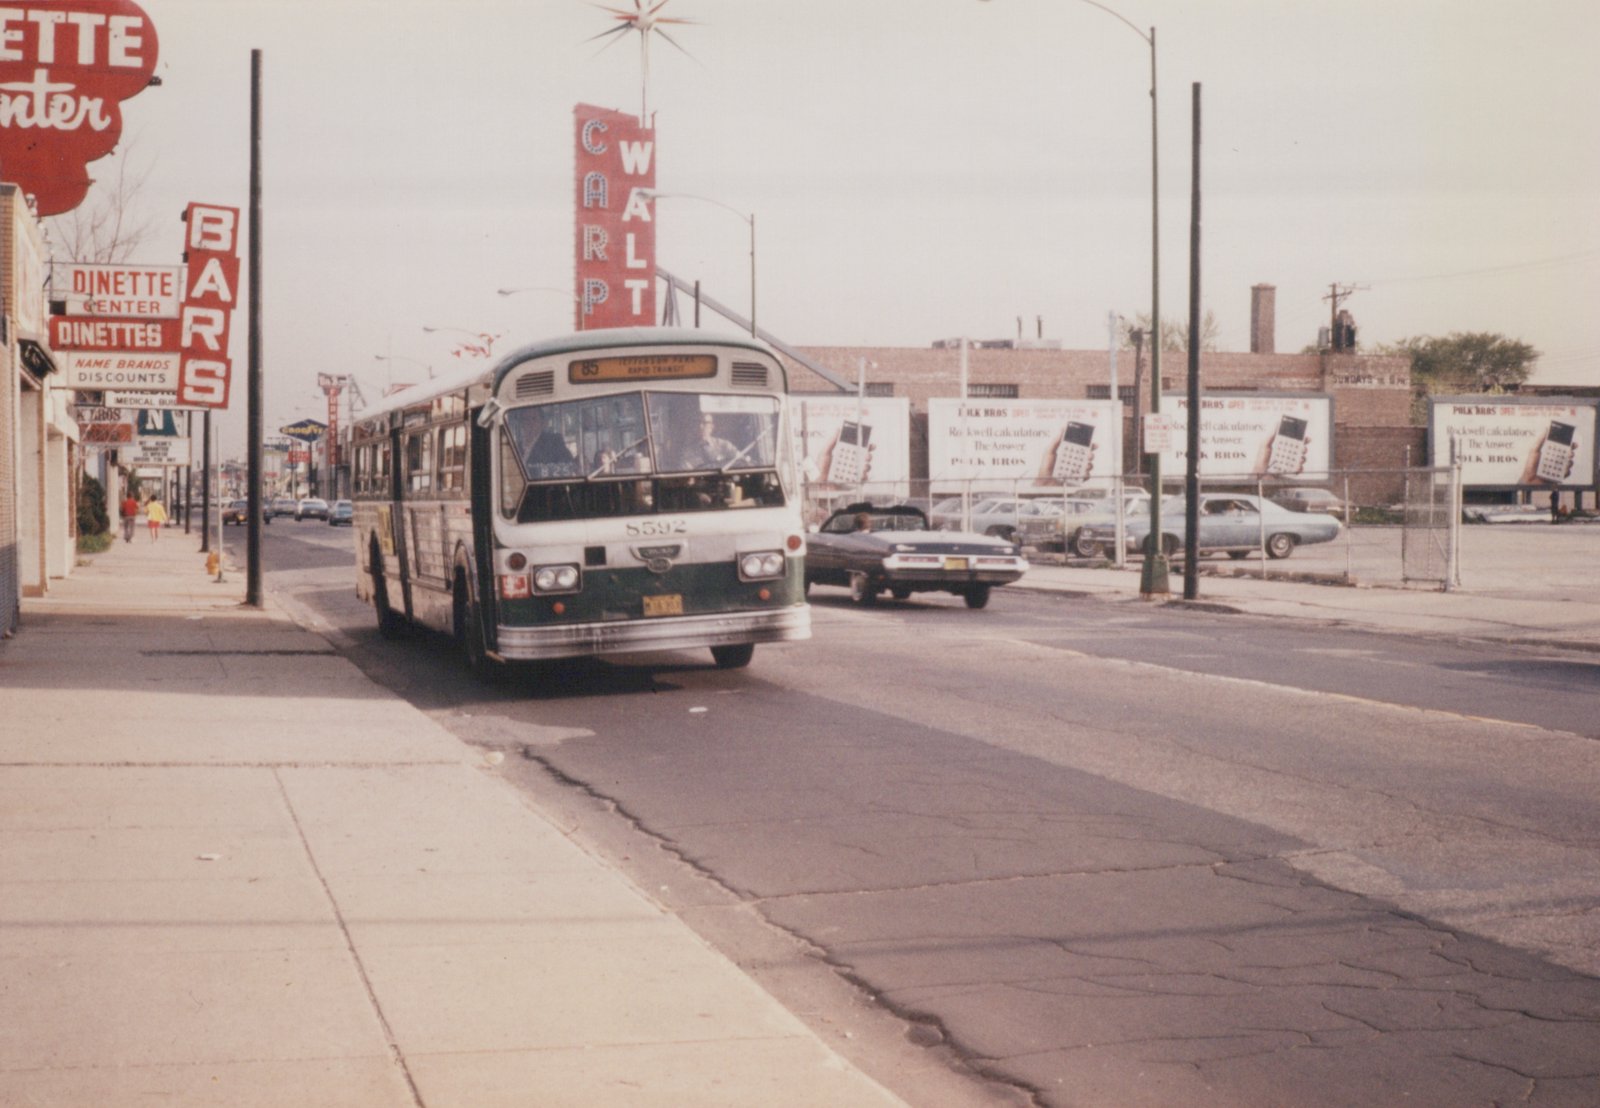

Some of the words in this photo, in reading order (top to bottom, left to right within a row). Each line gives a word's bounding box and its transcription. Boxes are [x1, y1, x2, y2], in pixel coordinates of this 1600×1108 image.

[581, 119, 609, 315] CARP
[619, 140, 653, 316] WALT
[73, 270, 173, 297] DINETTE
[83, 300, 161, 314] CENTER
[181, 206, 235, 404] BARS
[58, 321, 162, 348] DINETTES
[75, 359, 112, 369] NAME
[117, 360, 171, 371] BRANDS
[581, 361, 599, 376] 85
[79, 372, 166, 384] DISCOUNTS
[115, 397, 154, 405] MEDICAL
[949, 427, 992, 437] Rokwell
[1469, 439, 1483, 449] The
[1215, 451, 1247, 459] BROS
[1488, 455, 1518, 463] BROS
[626, 520, 687, 536] 8592
